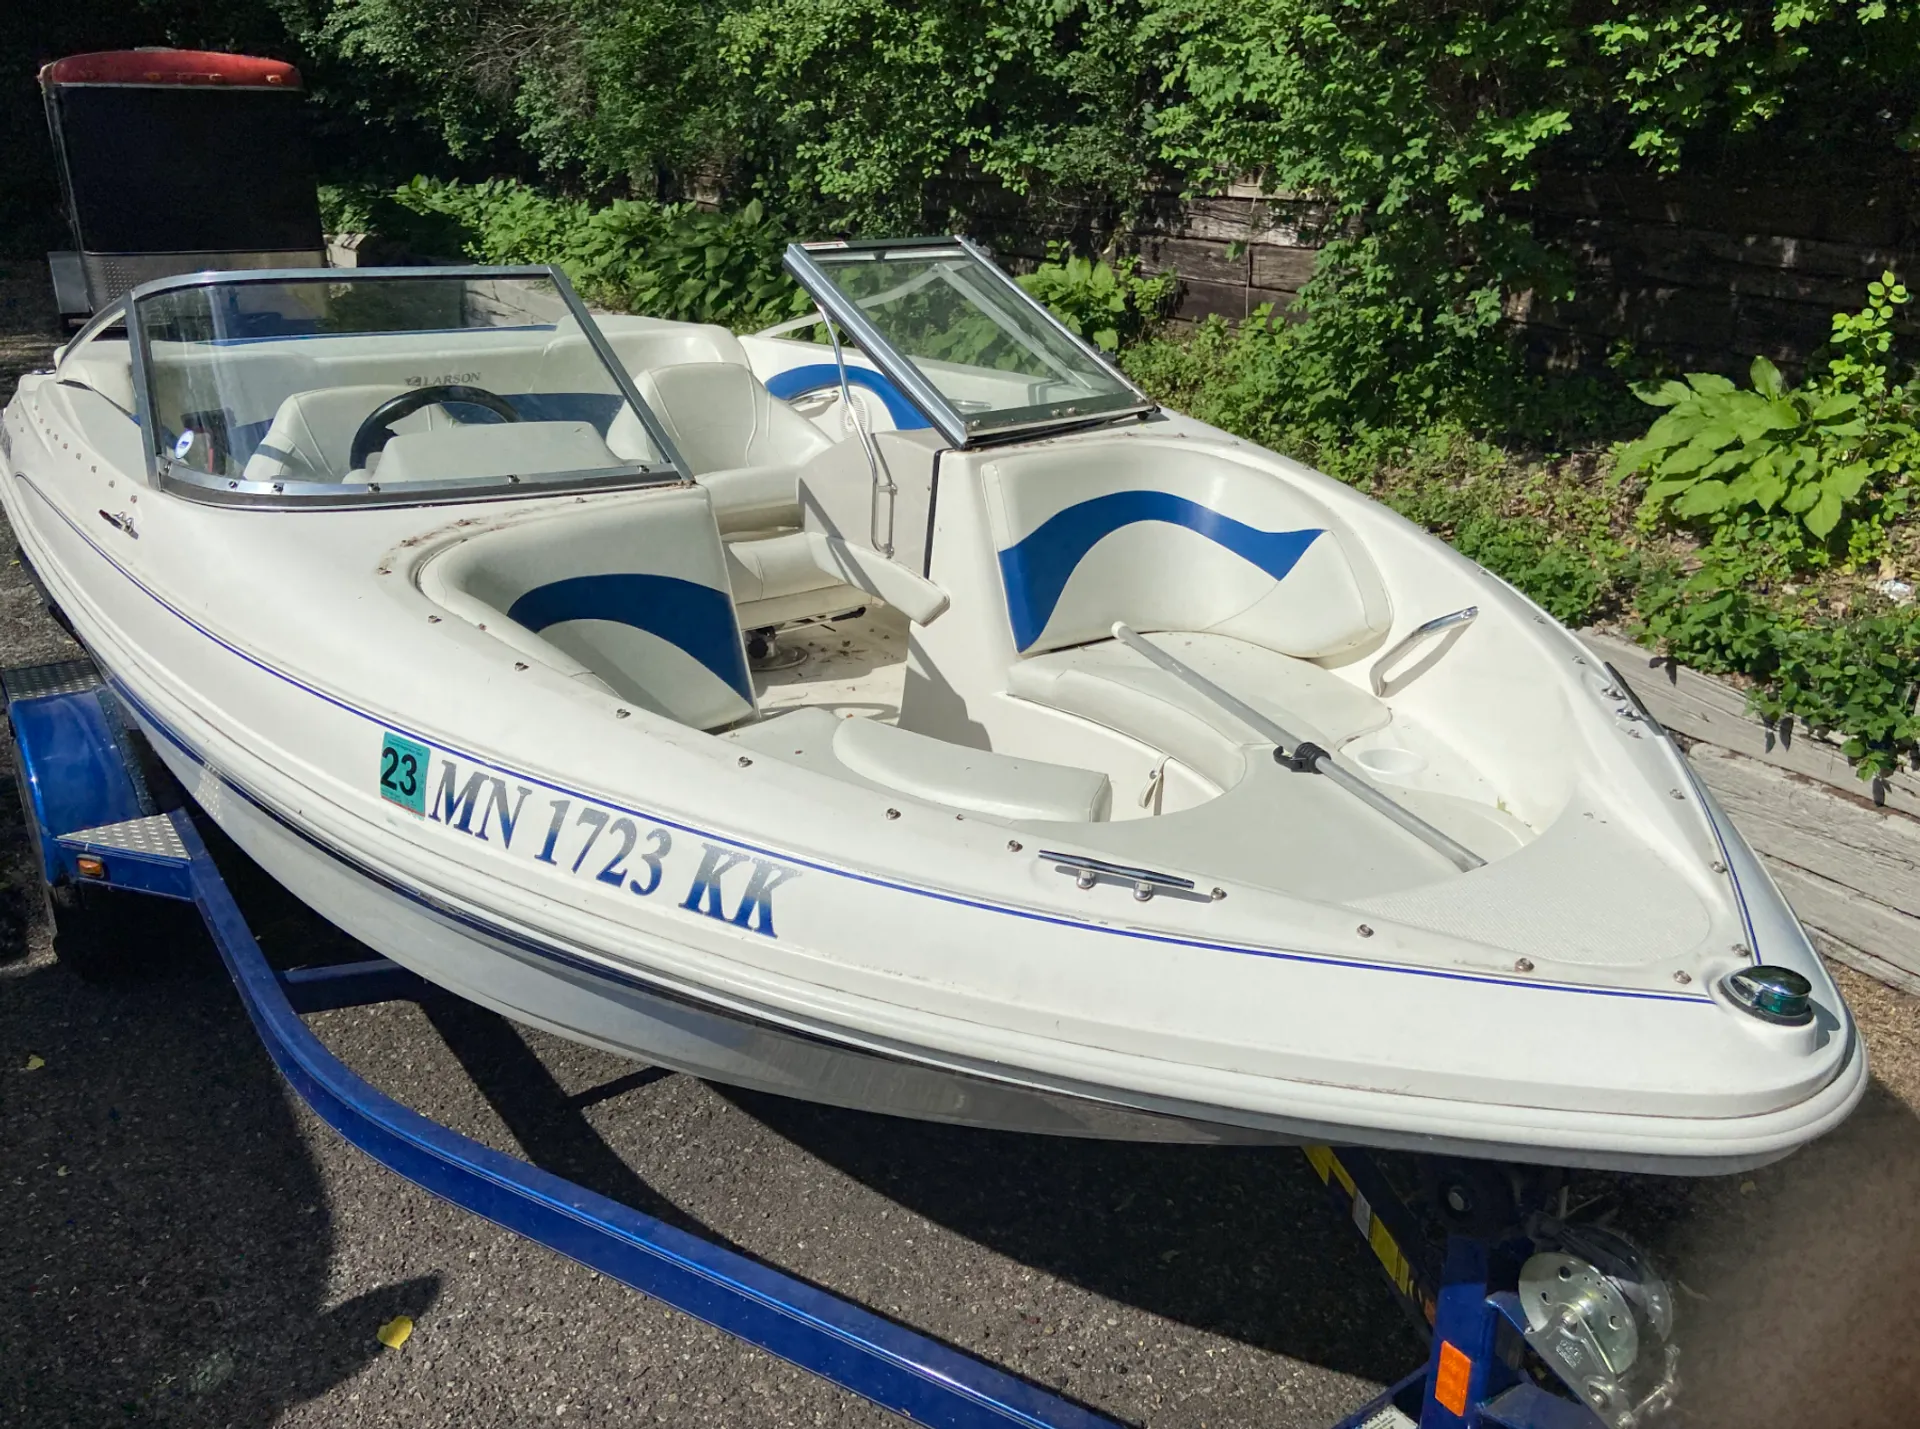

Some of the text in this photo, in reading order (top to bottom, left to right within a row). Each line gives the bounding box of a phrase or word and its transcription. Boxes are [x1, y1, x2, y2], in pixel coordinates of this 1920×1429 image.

[422, 372, 481, 387] LARSON
[380, 746, 418, 797] 23
[428, 760, 803, 939] MN 1723 KK
